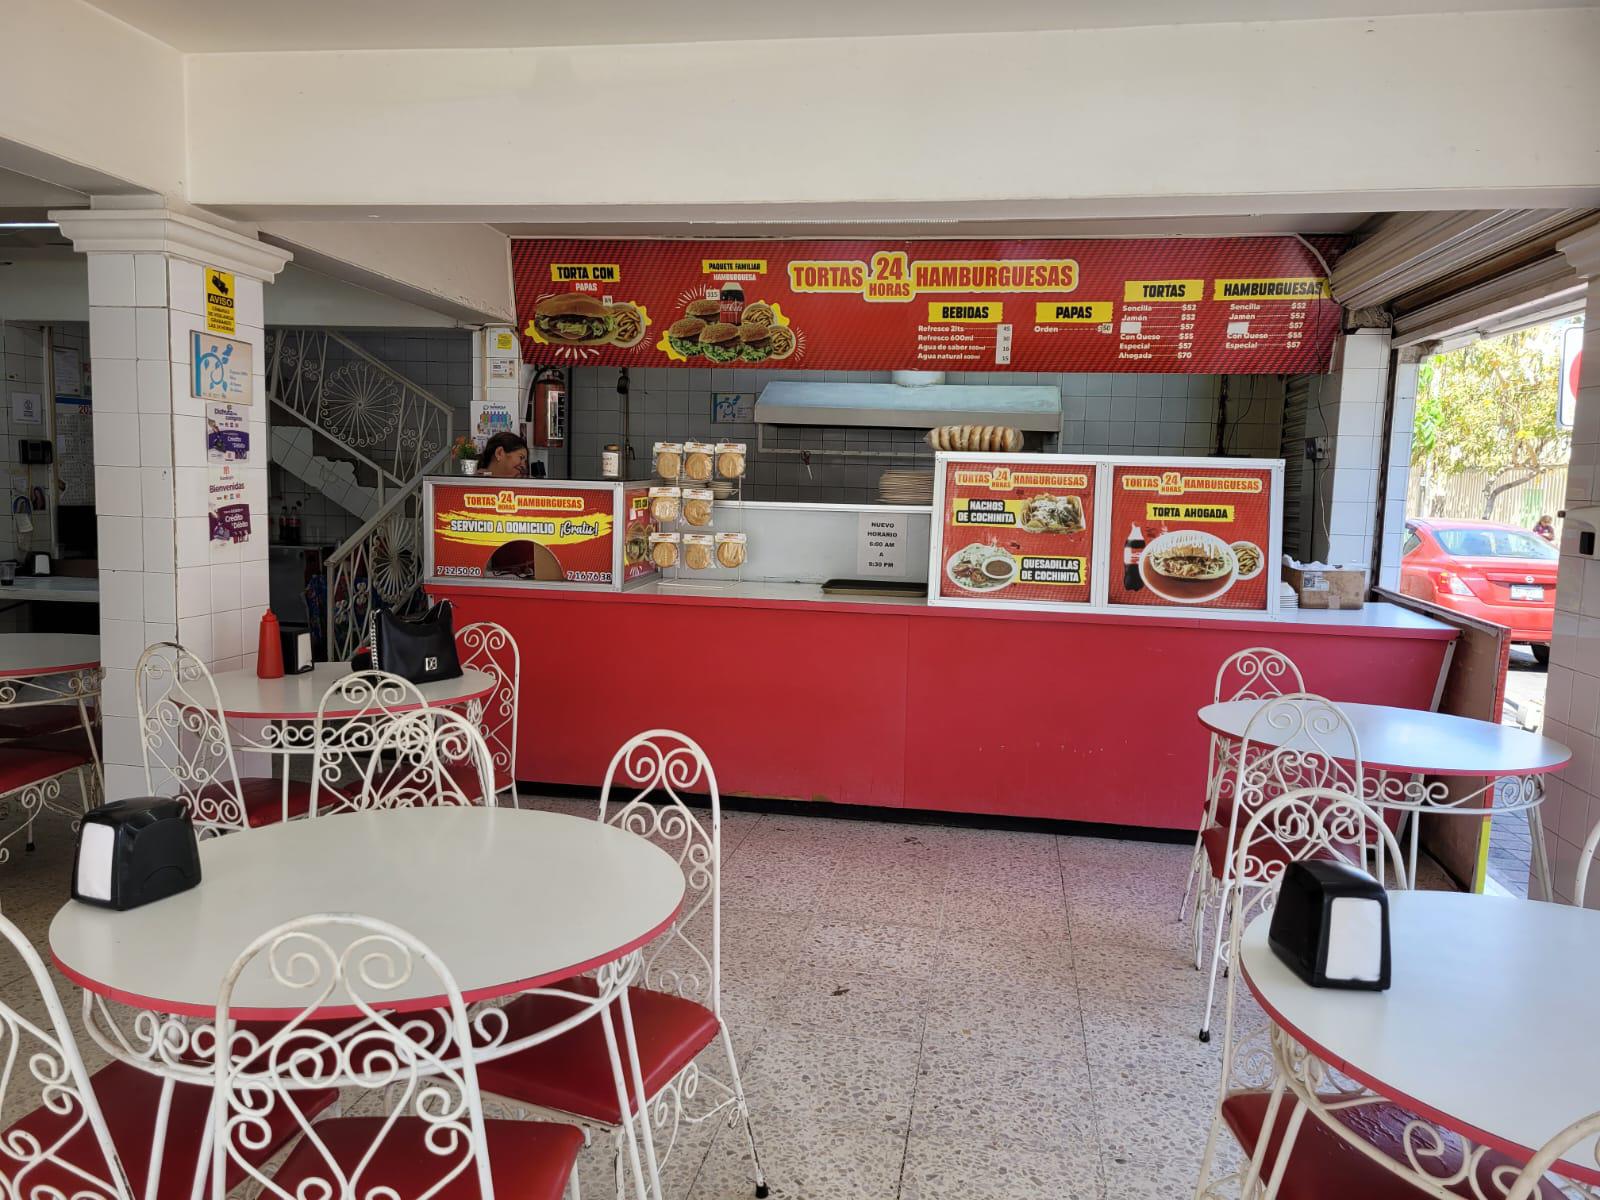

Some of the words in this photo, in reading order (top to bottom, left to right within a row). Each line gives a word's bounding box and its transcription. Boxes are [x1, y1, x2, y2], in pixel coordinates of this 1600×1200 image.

[557, 267, 590, 279] TORTA
[592, 267, 614, 279] CON
[794, 266, 863, 287] TORTAS
[876, 257, 903, 280] 24
[916, 265, 1073, 287] HAMBURGUESAS
[575, 283, 598, 291] PAPAS
[868, 283, 910, 297] HORAS
[1143, 284, 1186, 298] TORTAS
[1224, 281, 1323, 297] HAMBURGUESAS
[210, 294, 233, 307] AVISO
[942, 306, 989, 319] BEBIDAS
[1055, 306, 1093, 319] PAPAS
[1225, 342, 1258, 350] Especial
[1119, 352, 1153, 360] Ahogada
[957, 473, 990, 484] TORTAS
[993, 470, 1008, 481] 24
[1013, 474, 1085, 486] HAMBURGUESAS
[1125, 477, 1159, 488] TORTAS
[1165, 474, 1178, 485] 24
[1184, 479, 1259, 490] HAMBURGUESAS
[466, 496, 496, 506] TORTAS
[500, 493, 513, 503] 24
[517, 496, 583, 509] HAMBURGUESAS
[970, 501, 1004, 511] NACHOS
[958, 512, 969, 521] DE
[970, 512, 1015, 523] COCHINITA
[1152, 507, 1181, 517] TORTA
[1184, 507, 1229, 518] AHOGADA
[451, 520, 494, 533] SERVICIO
[496, 521, 504, 533] A
[505, 521, 556, 535] DOMICILIO
[559, 520, 599, 538] ¡Gratis!
[1023, 558, 1079, 570] QUESADILLAS
[1021, 570, 1033, 580] DE
[1034, 571, 1079, 582] COCHINITA
